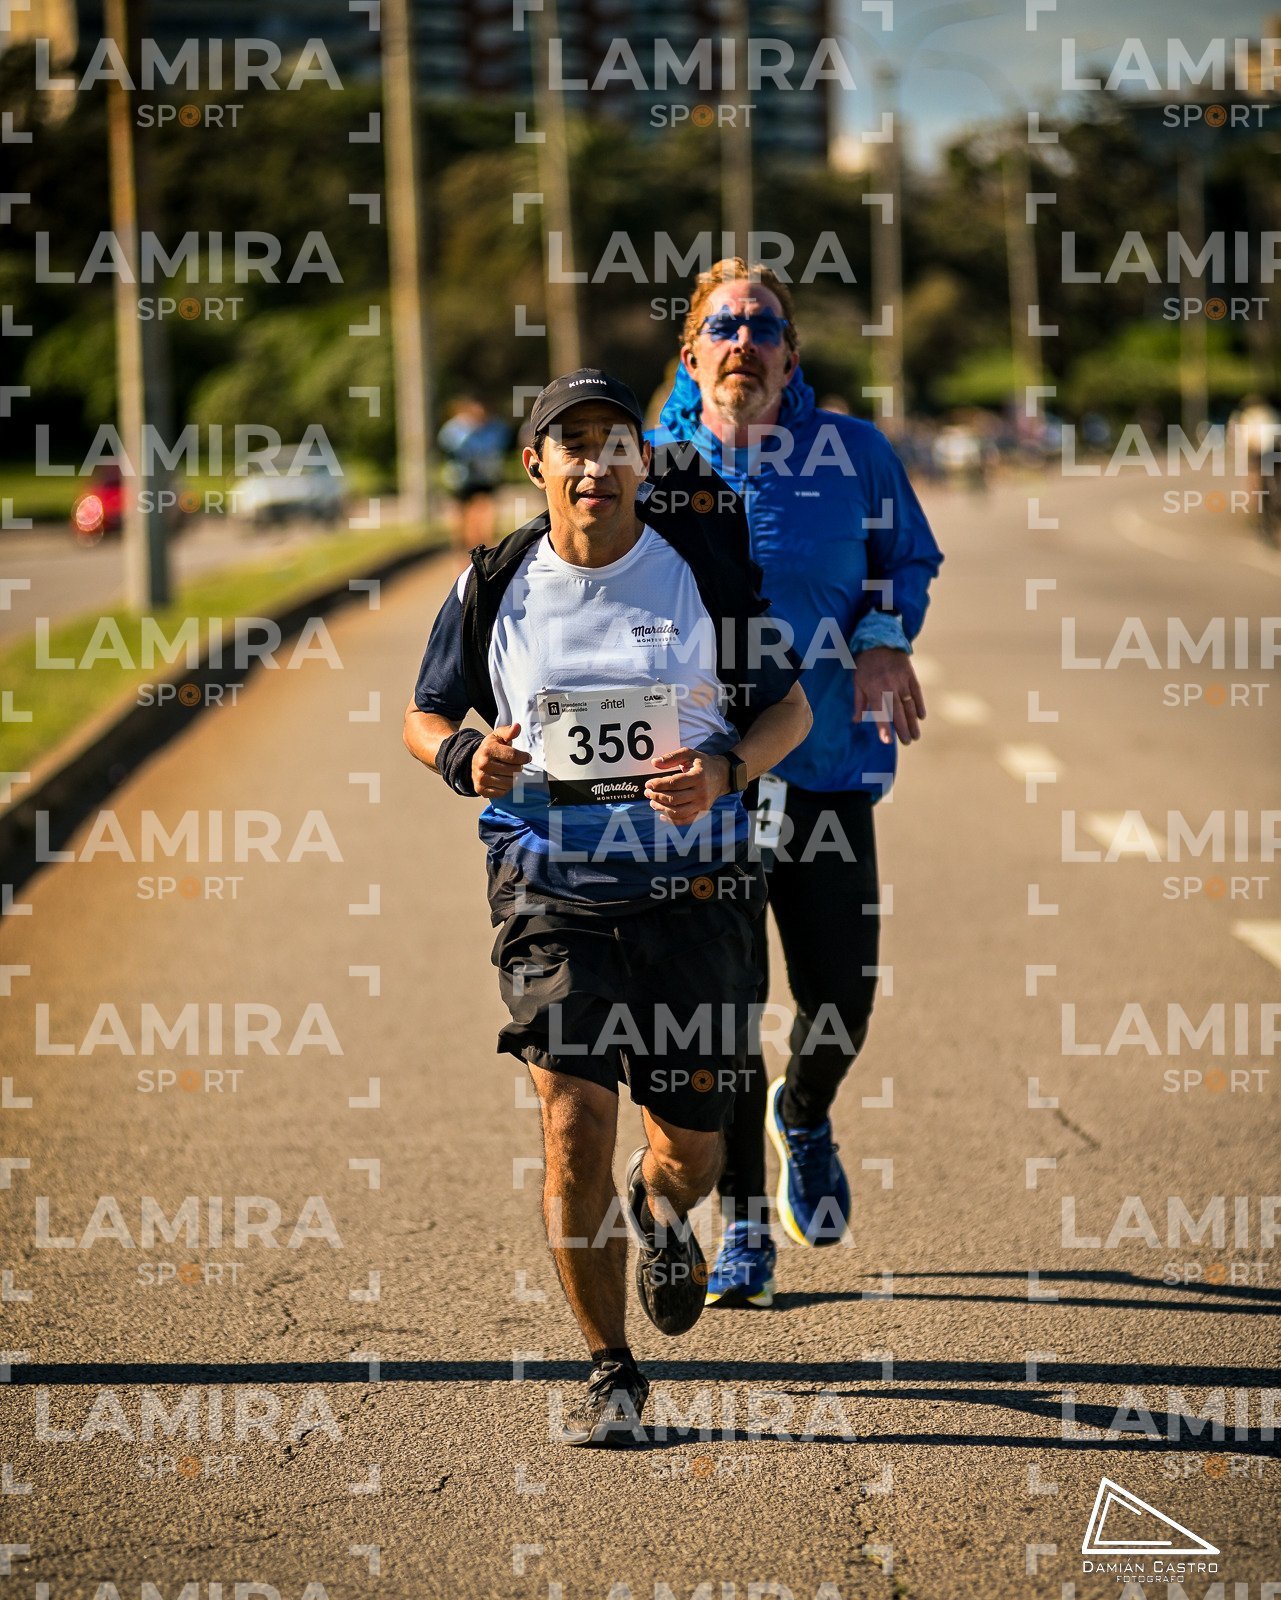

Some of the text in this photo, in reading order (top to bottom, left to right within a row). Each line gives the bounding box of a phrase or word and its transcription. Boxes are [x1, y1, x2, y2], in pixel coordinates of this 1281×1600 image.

[568, 379, 607, 388] KIPRUN
[631, 624, 680, 637] Maratón
[601, 698, 625, 710] antel
[568, 720, 654, 765] 356
[591, 781, 639, 796] Maratón
